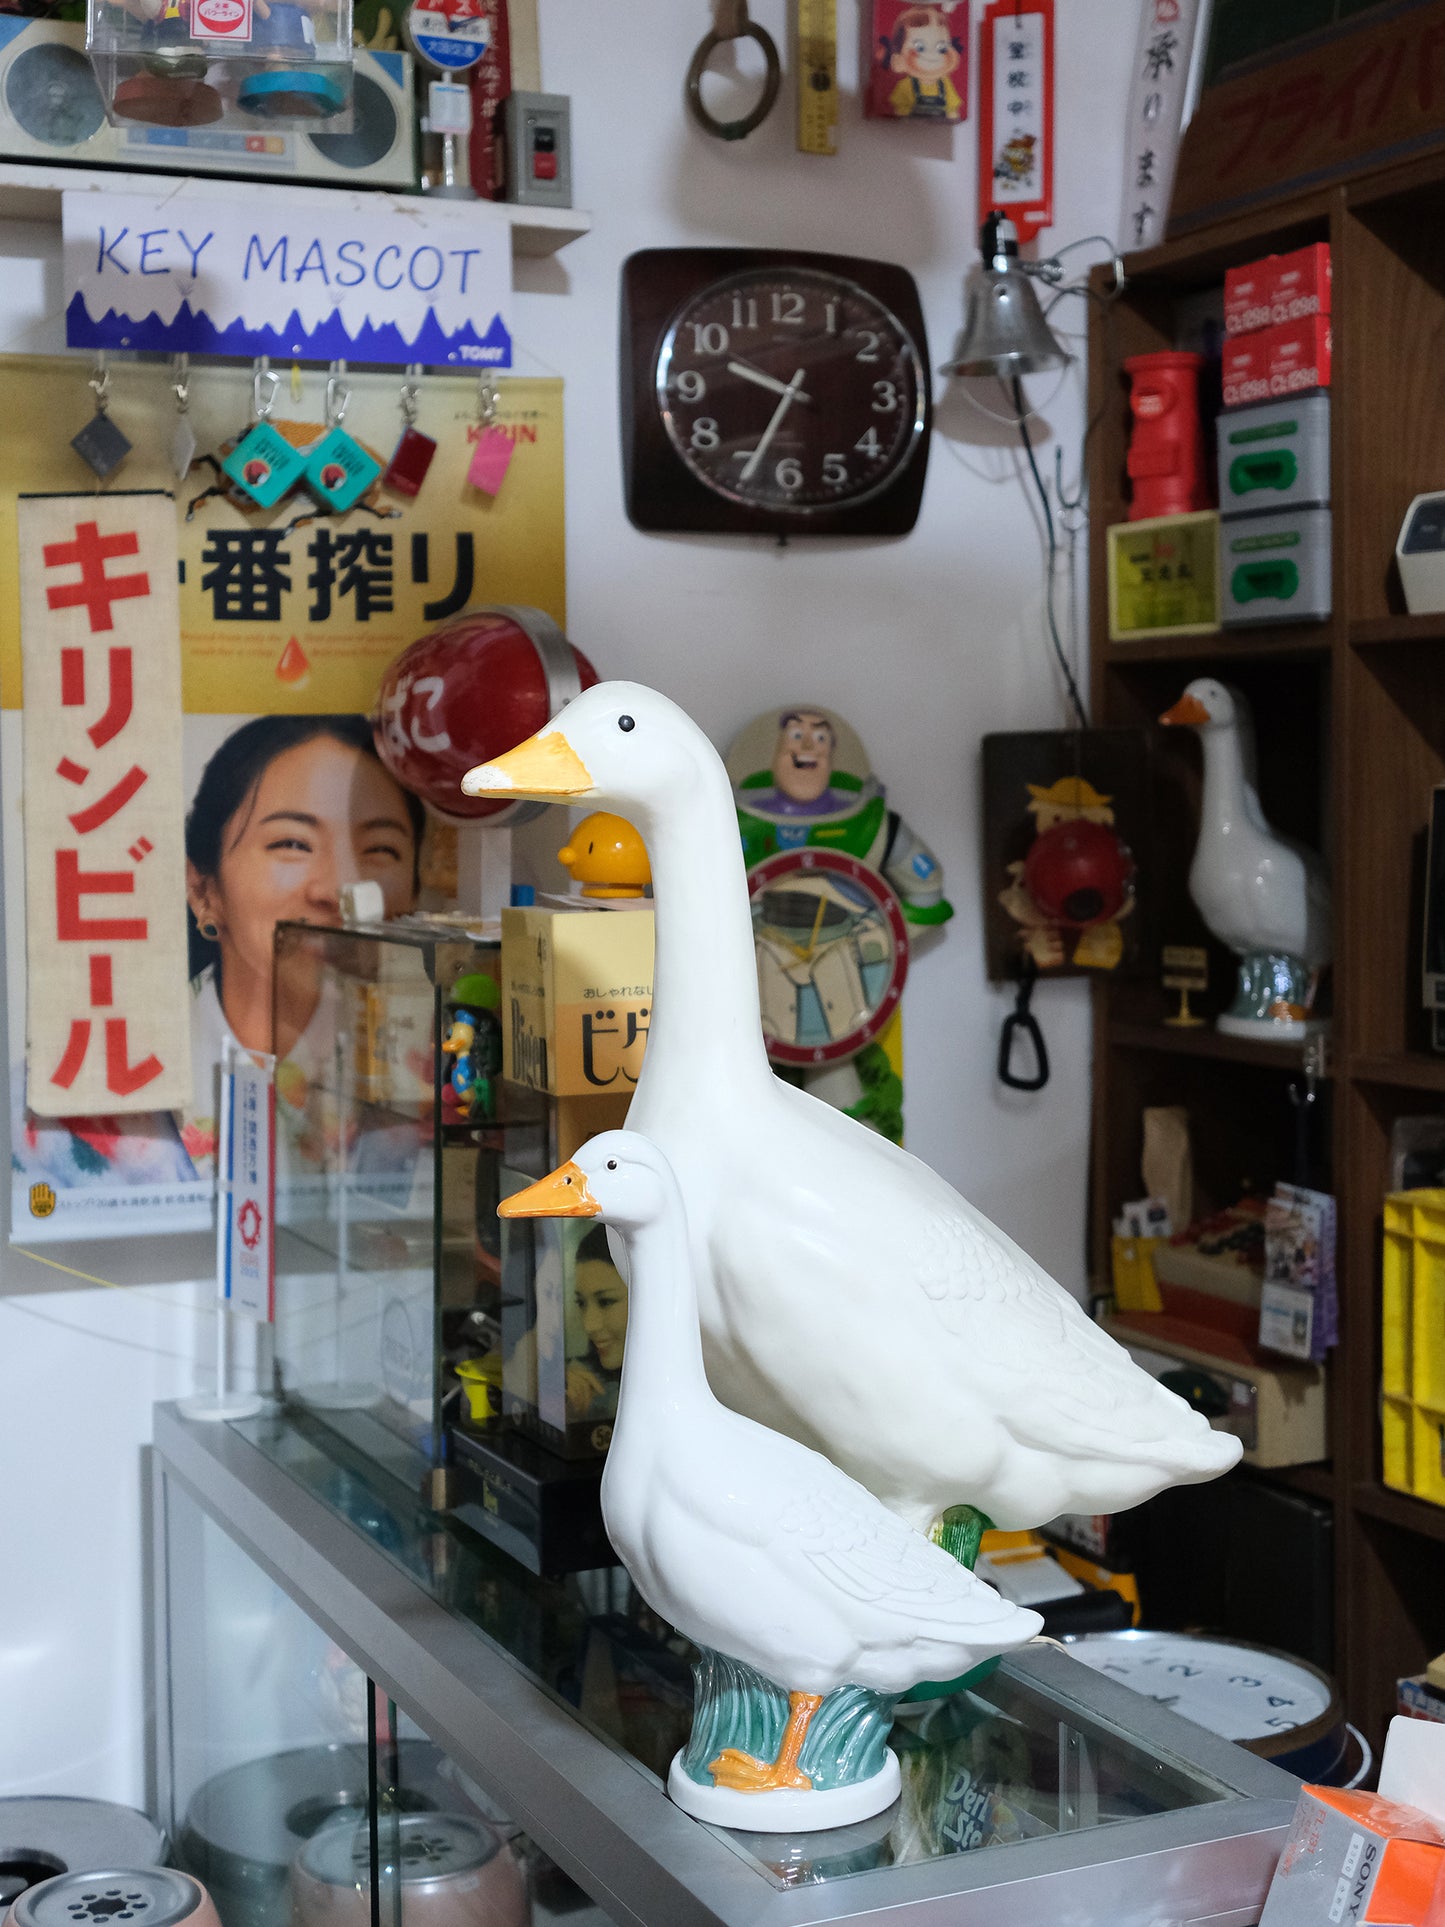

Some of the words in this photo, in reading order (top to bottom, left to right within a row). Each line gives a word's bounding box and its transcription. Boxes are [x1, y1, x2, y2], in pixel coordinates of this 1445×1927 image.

[97, 227, 214, 279] KEY
[243, 235, 481, 294] MASCOT
[731, 297, 759, 329] 11
[771, 292, 806, 324] 12
[825, 303, 837, 333] 1
[459, 346, 504, 360] TOMY
[692, 323, 730, 356] 10
[855, 331, 880, 362] 2
[676, 370, 706, 403] 9
[871, 381, 897, 412] 3
[690, 417, 720, 449] 8
[854, 426, 882, 458] 4
[775, 458, 804, 489] 6
[822, 454, 848, 484] 5
[178, 529, 474, 622] 番搾り
[42, 521, 164, 1096] キリンビール
[1168, 1665, 1202, 1677] 2
[1229, 1676, 1262, 1688] 3
[1267, 1696, 1295, 1708] 4
[1266, 1717, 1298, 1731] 5
[1349, 1843, 1377, 1918] SONY
